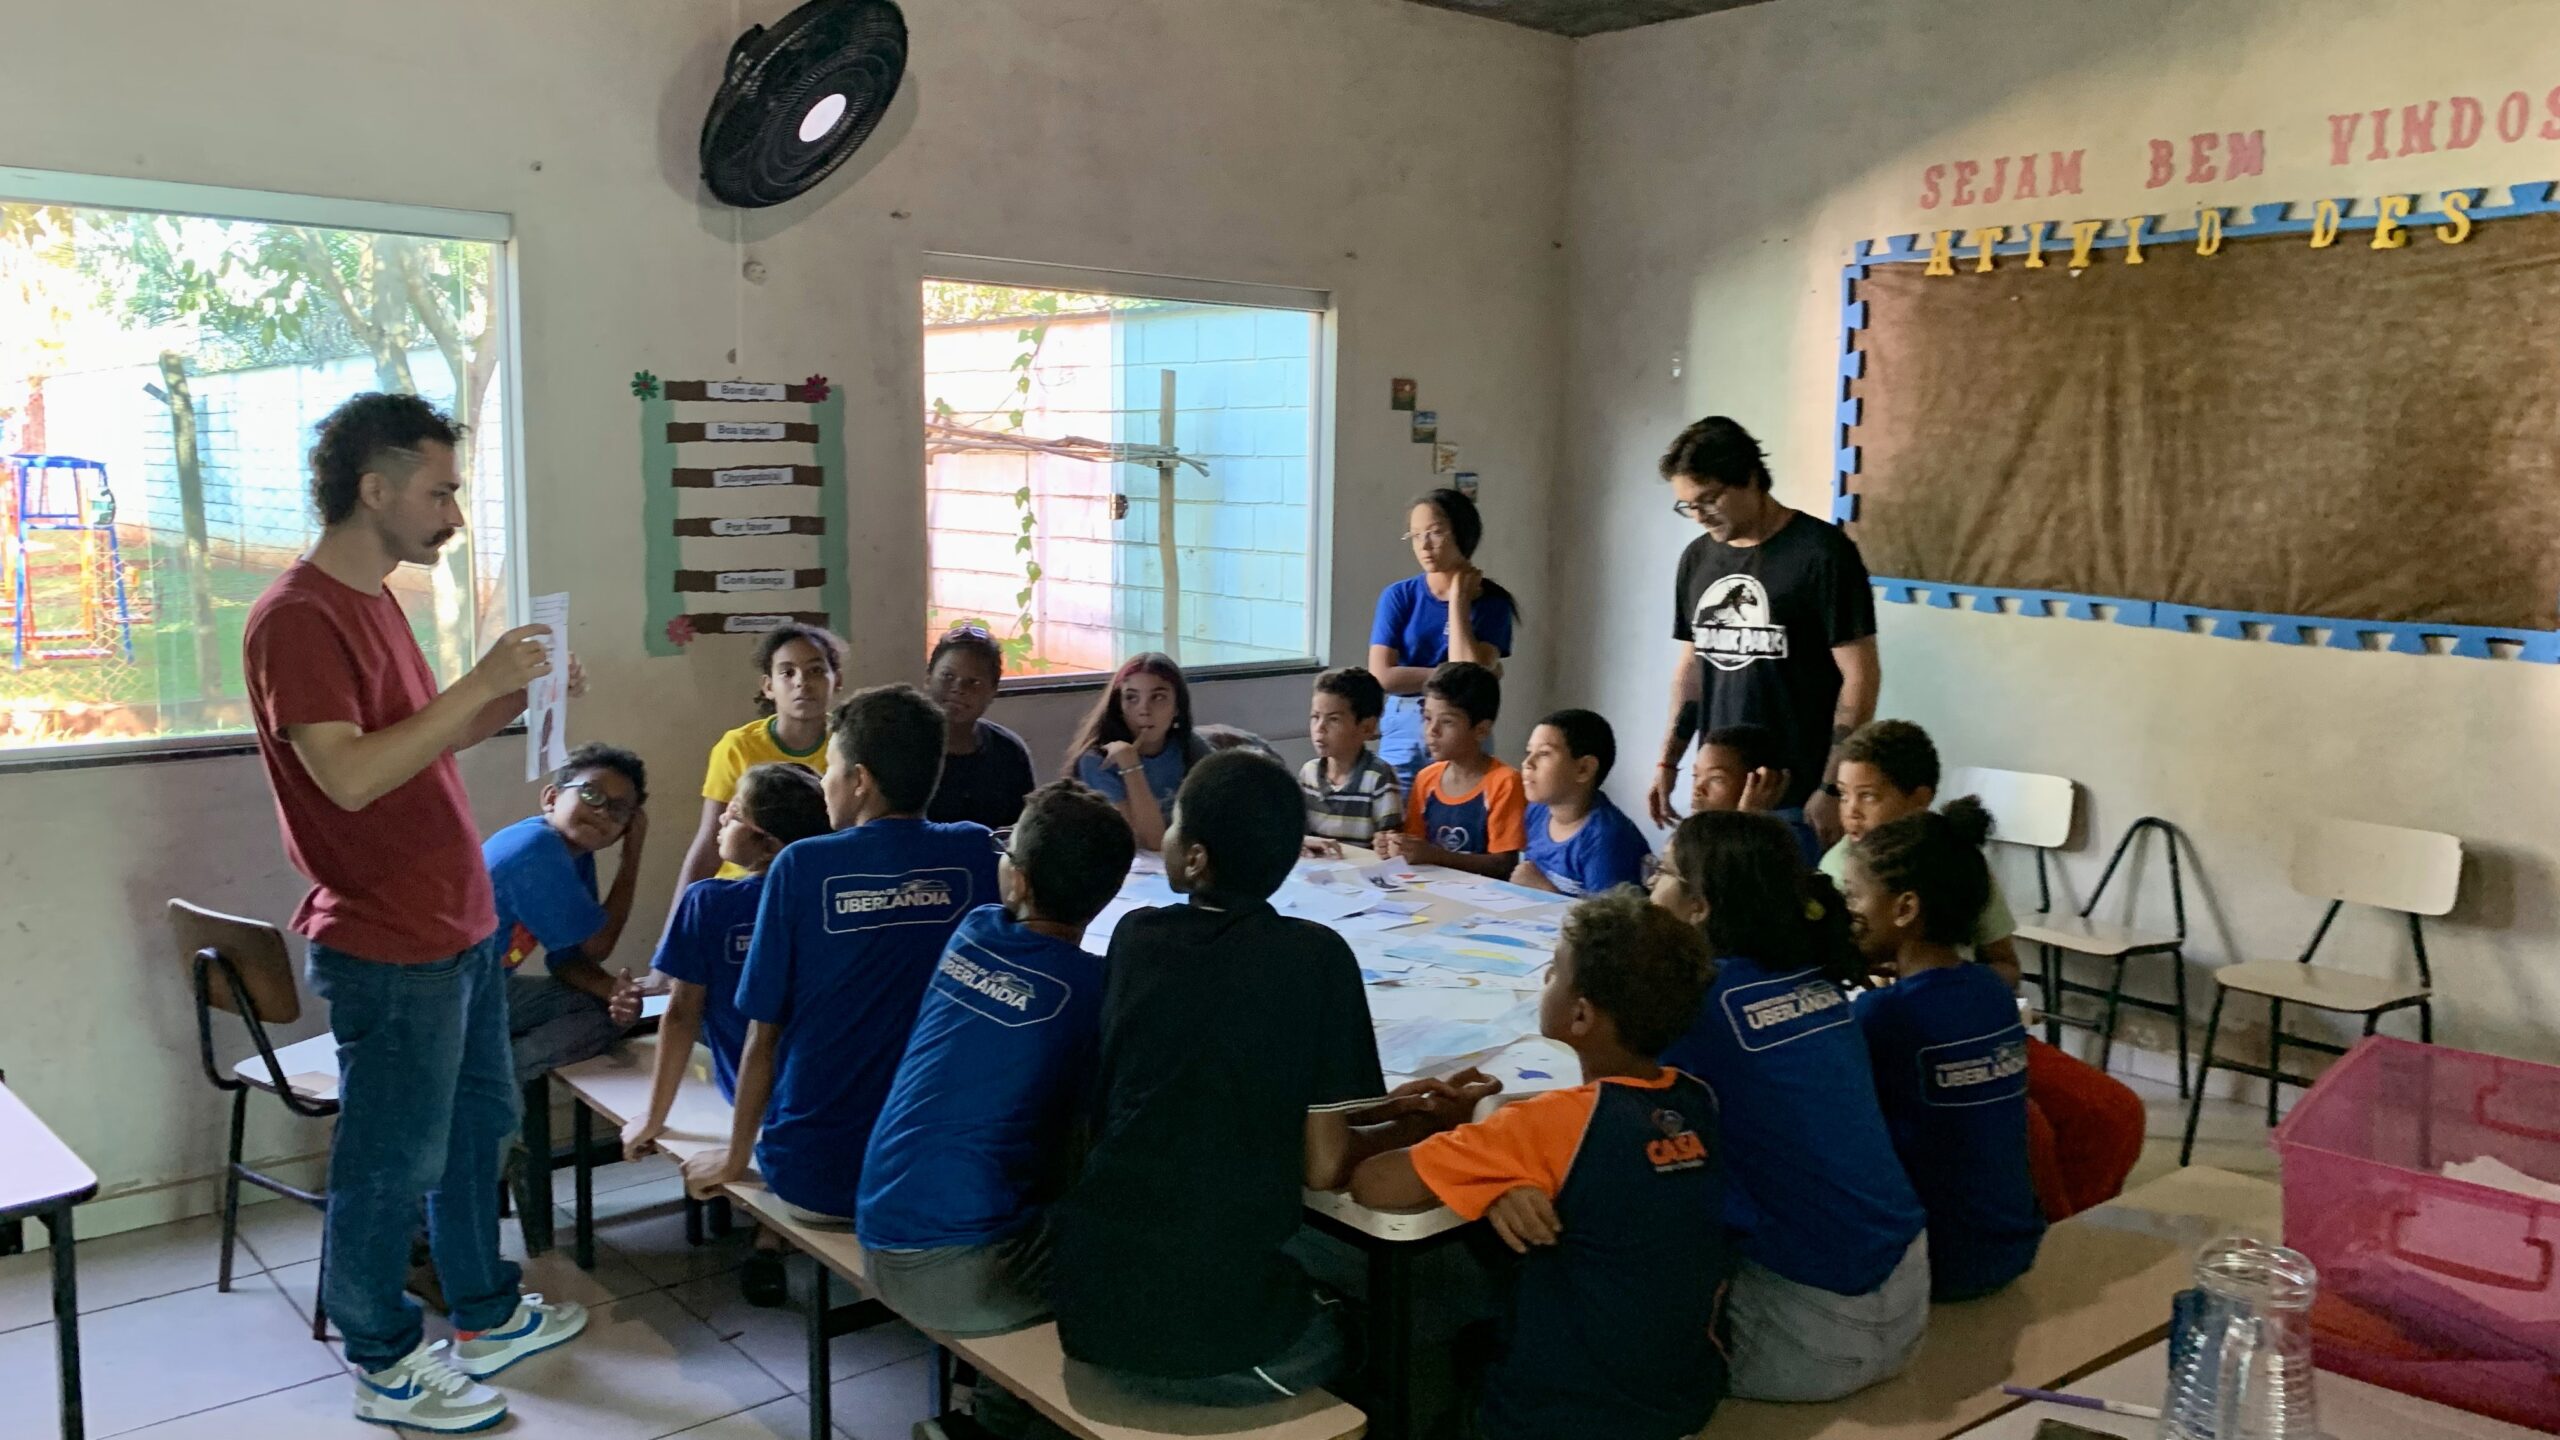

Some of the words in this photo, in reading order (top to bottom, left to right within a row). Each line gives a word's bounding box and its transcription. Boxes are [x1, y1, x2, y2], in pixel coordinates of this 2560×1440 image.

[1919, 149, 2086, 210] SEJAM
[2145, 129, 2266, 190] BEM
[2327, 85, 2560, 167] VINDOS
